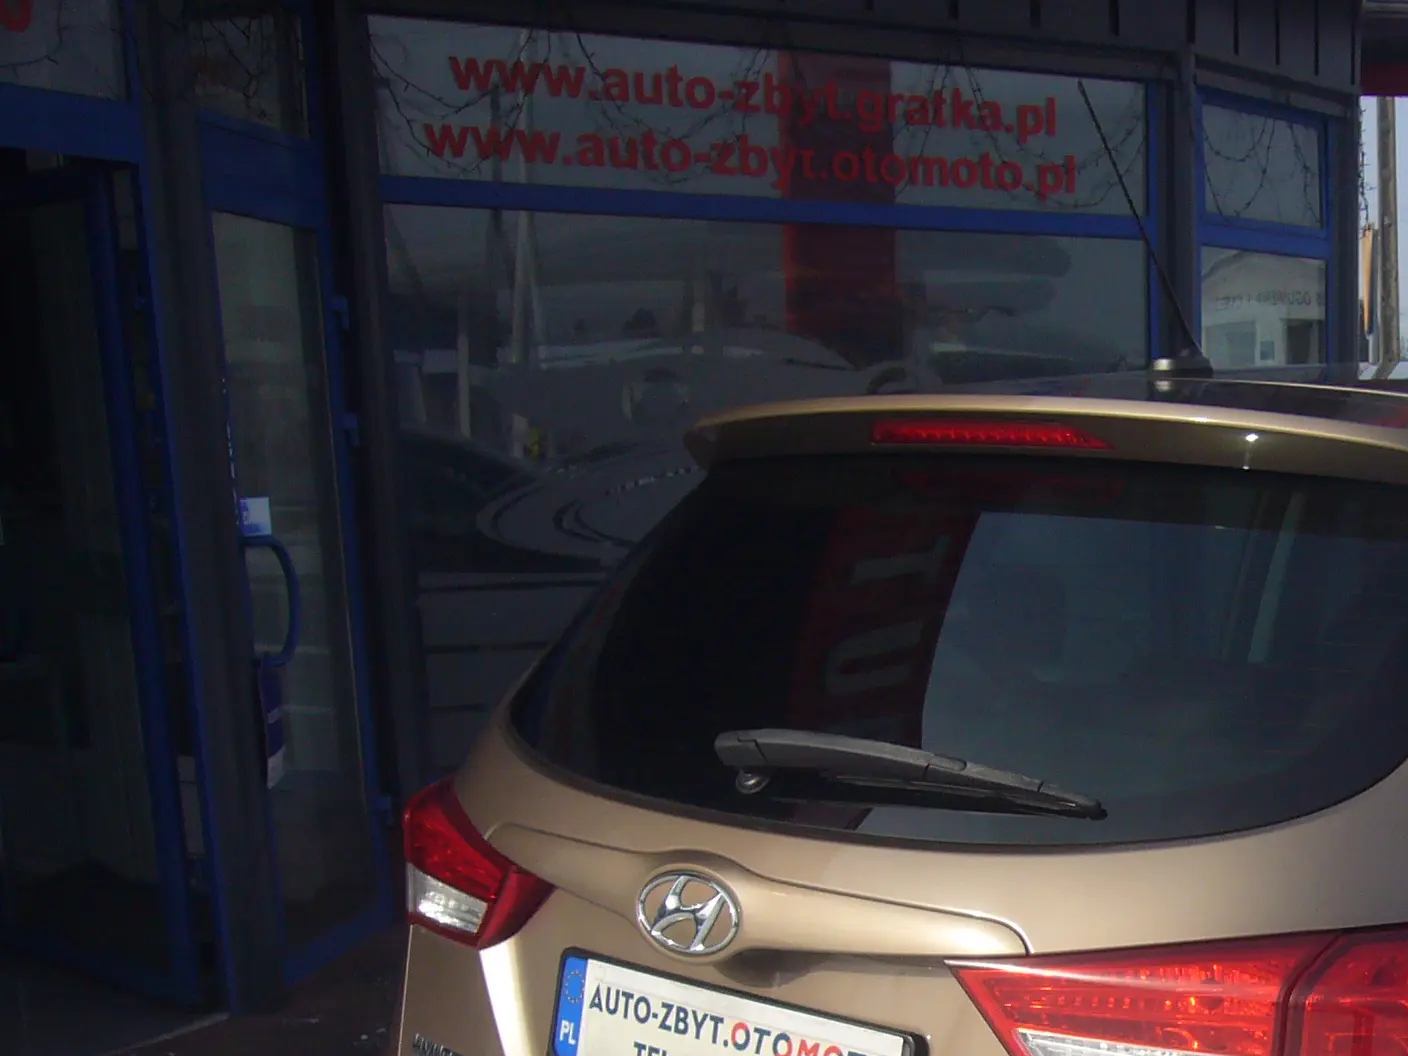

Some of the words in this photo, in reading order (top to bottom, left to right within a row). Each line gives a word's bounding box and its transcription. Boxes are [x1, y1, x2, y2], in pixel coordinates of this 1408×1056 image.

[449, 55, 1057, 144] www.auto-zbyt.gratka.pl
[424, 122, 1077, 201] www.auto-zbyt.otomoto.pl
[559, 1019, 577, 1046] PL
